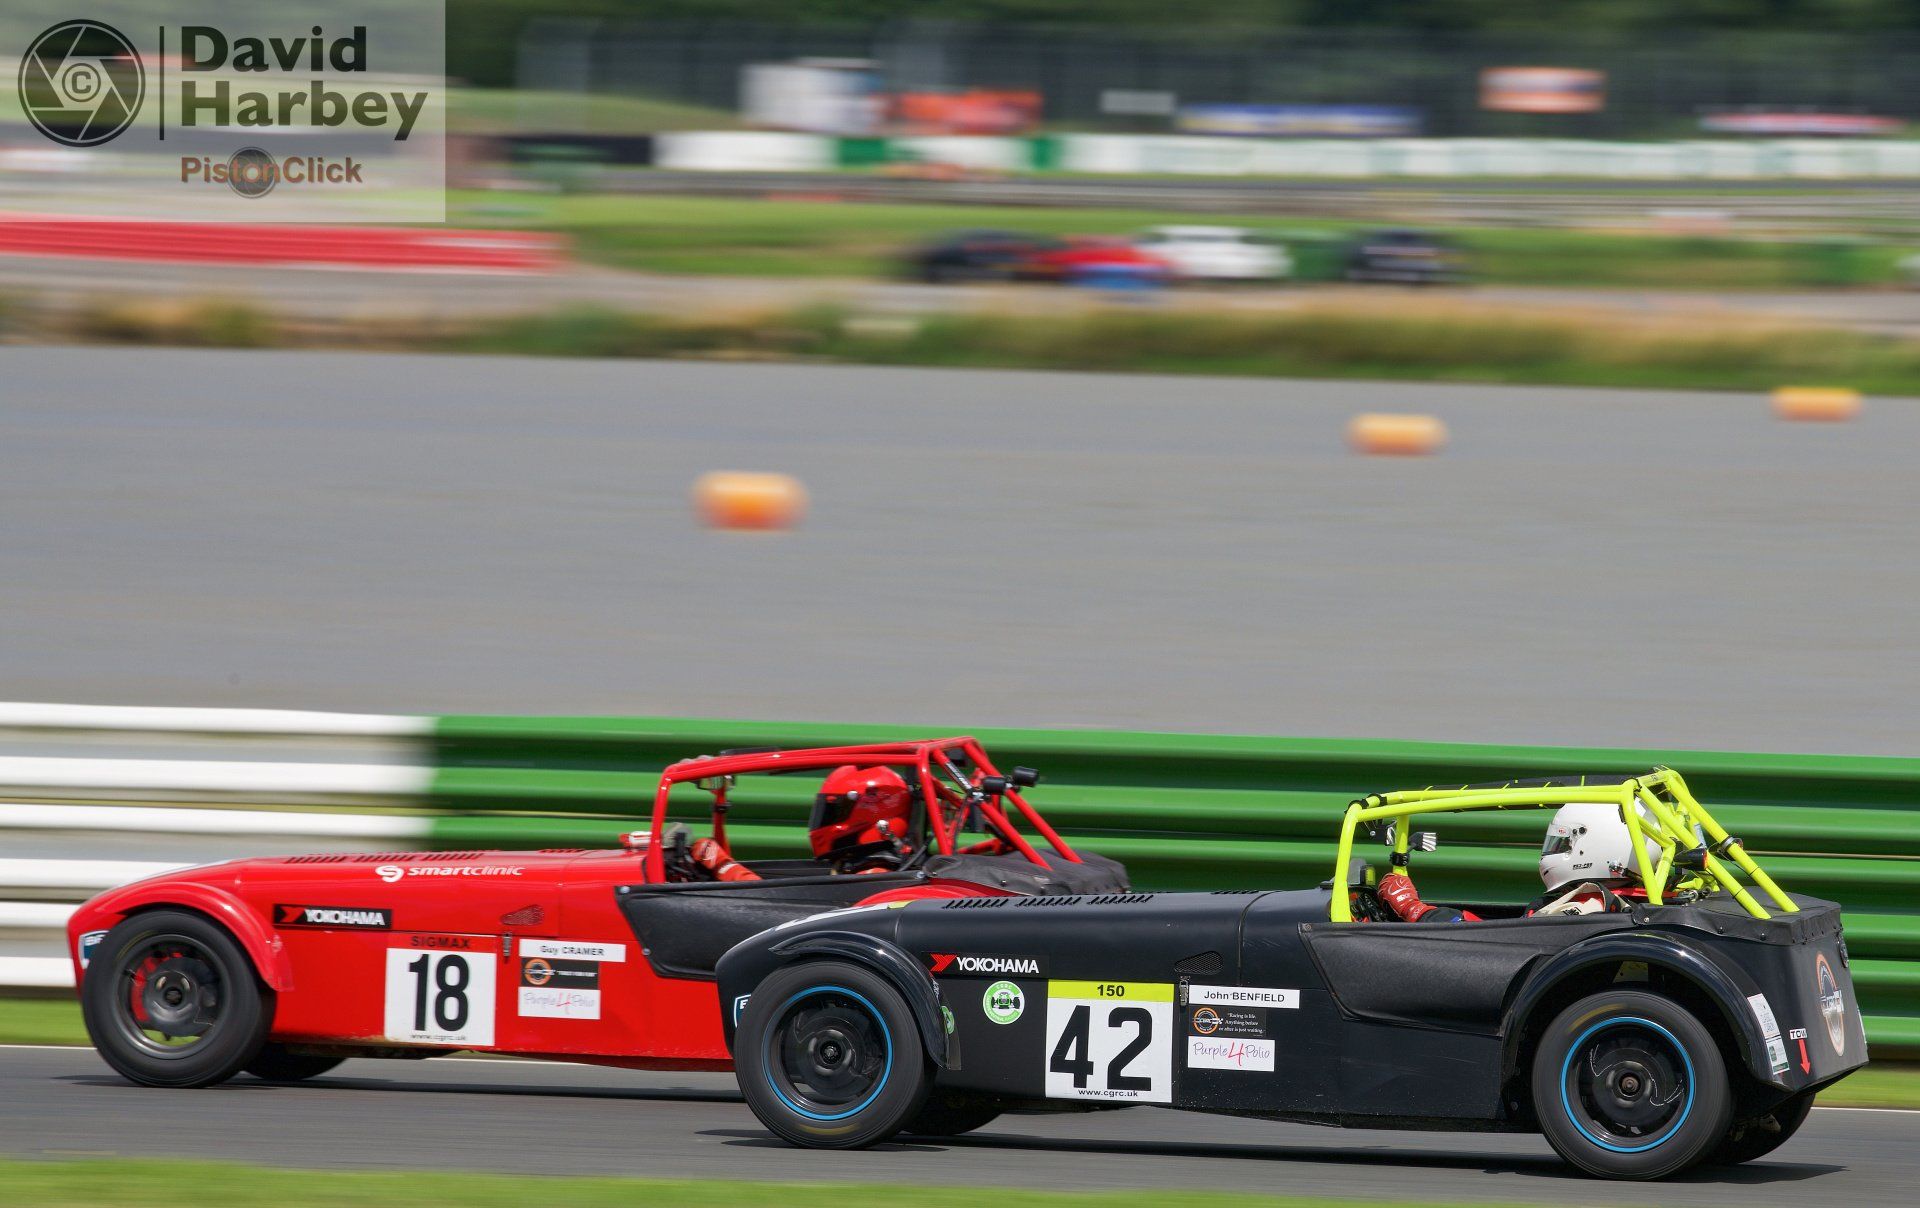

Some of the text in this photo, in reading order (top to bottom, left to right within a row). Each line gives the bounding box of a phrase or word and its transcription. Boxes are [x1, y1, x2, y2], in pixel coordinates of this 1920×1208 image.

[407, 864, 526, 877] smartclinic
[304, 908, 386, 926] YOKOHAMA
[411, 935, 470, 949] SIGMAX
[540, 944, 605, 956] Guy CRAMER
[956, 956, 1040, 974] YOKOHAMA
[408, 953, 470, 1032] 18
[1097, 984, 1126, 997] 150
[1204, 990, 1286, 1003] John BENFIELD
[1050, 1004, 1153, 1092] 42
[1078, 1088, 1139, 1098] www.cgrc.uk
